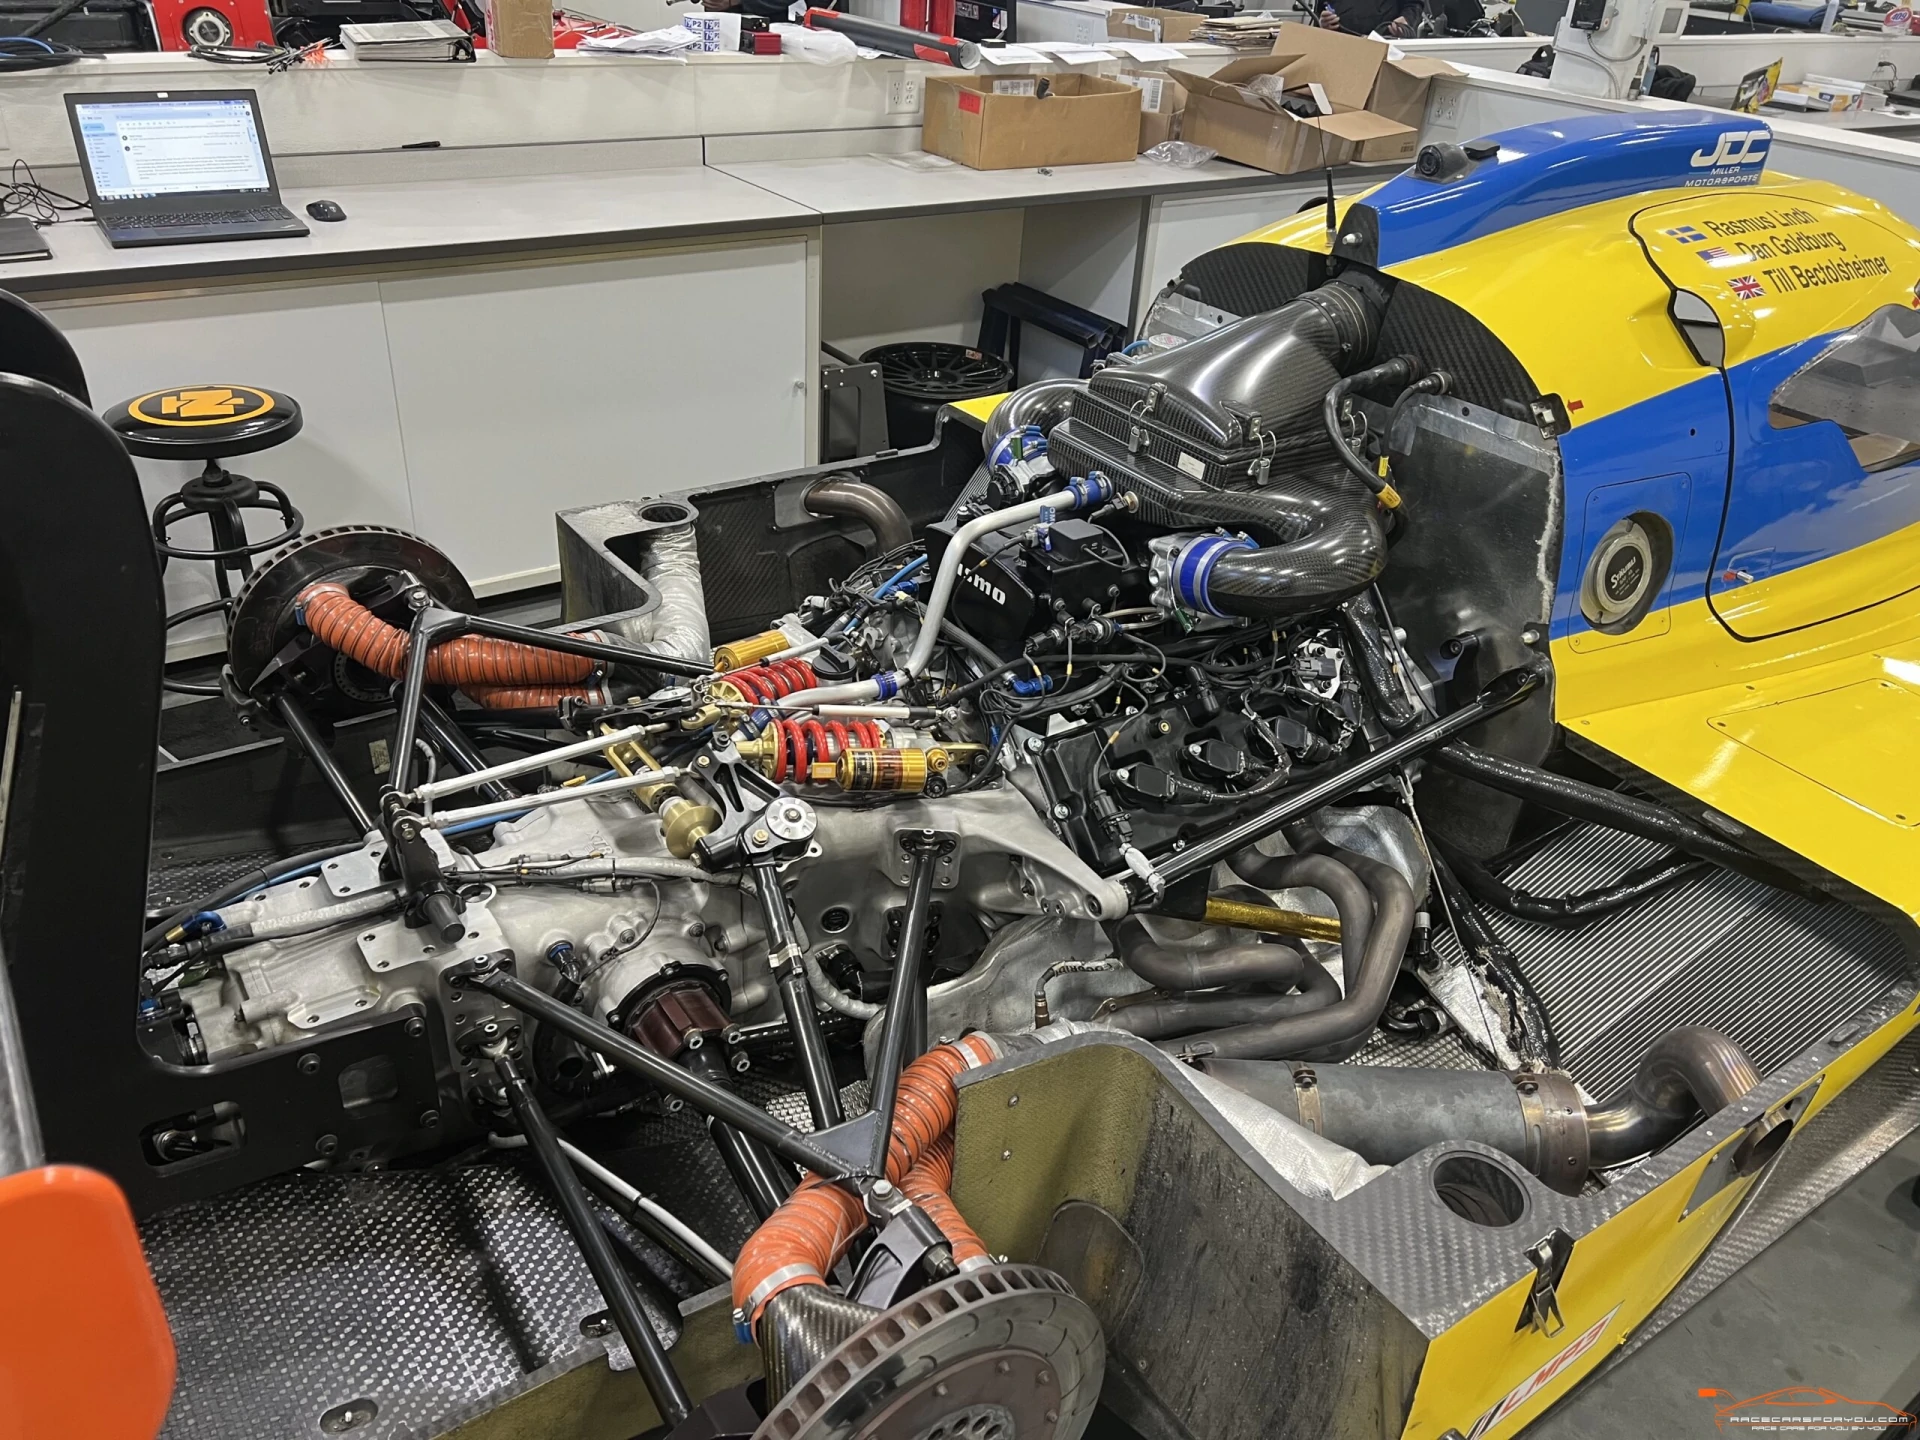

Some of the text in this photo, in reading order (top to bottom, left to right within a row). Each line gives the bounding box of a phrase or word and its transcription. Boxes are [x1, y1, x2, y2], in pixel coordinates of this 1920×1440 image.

[1690, 130, 1771, 167] JDC
[1684, 174, 1759, 187] MOTORSPORTS
[1710, 166, 1740, 175] MILLER
[1702, 208, 1819, 238] Rasmus Lindh
[1735, 231, 1847, 262] Dan Goldburg
[1762, 255, 1892, 294] Till Bectolsheimer
[1500, 1316, 1610, 1417] LMP3
